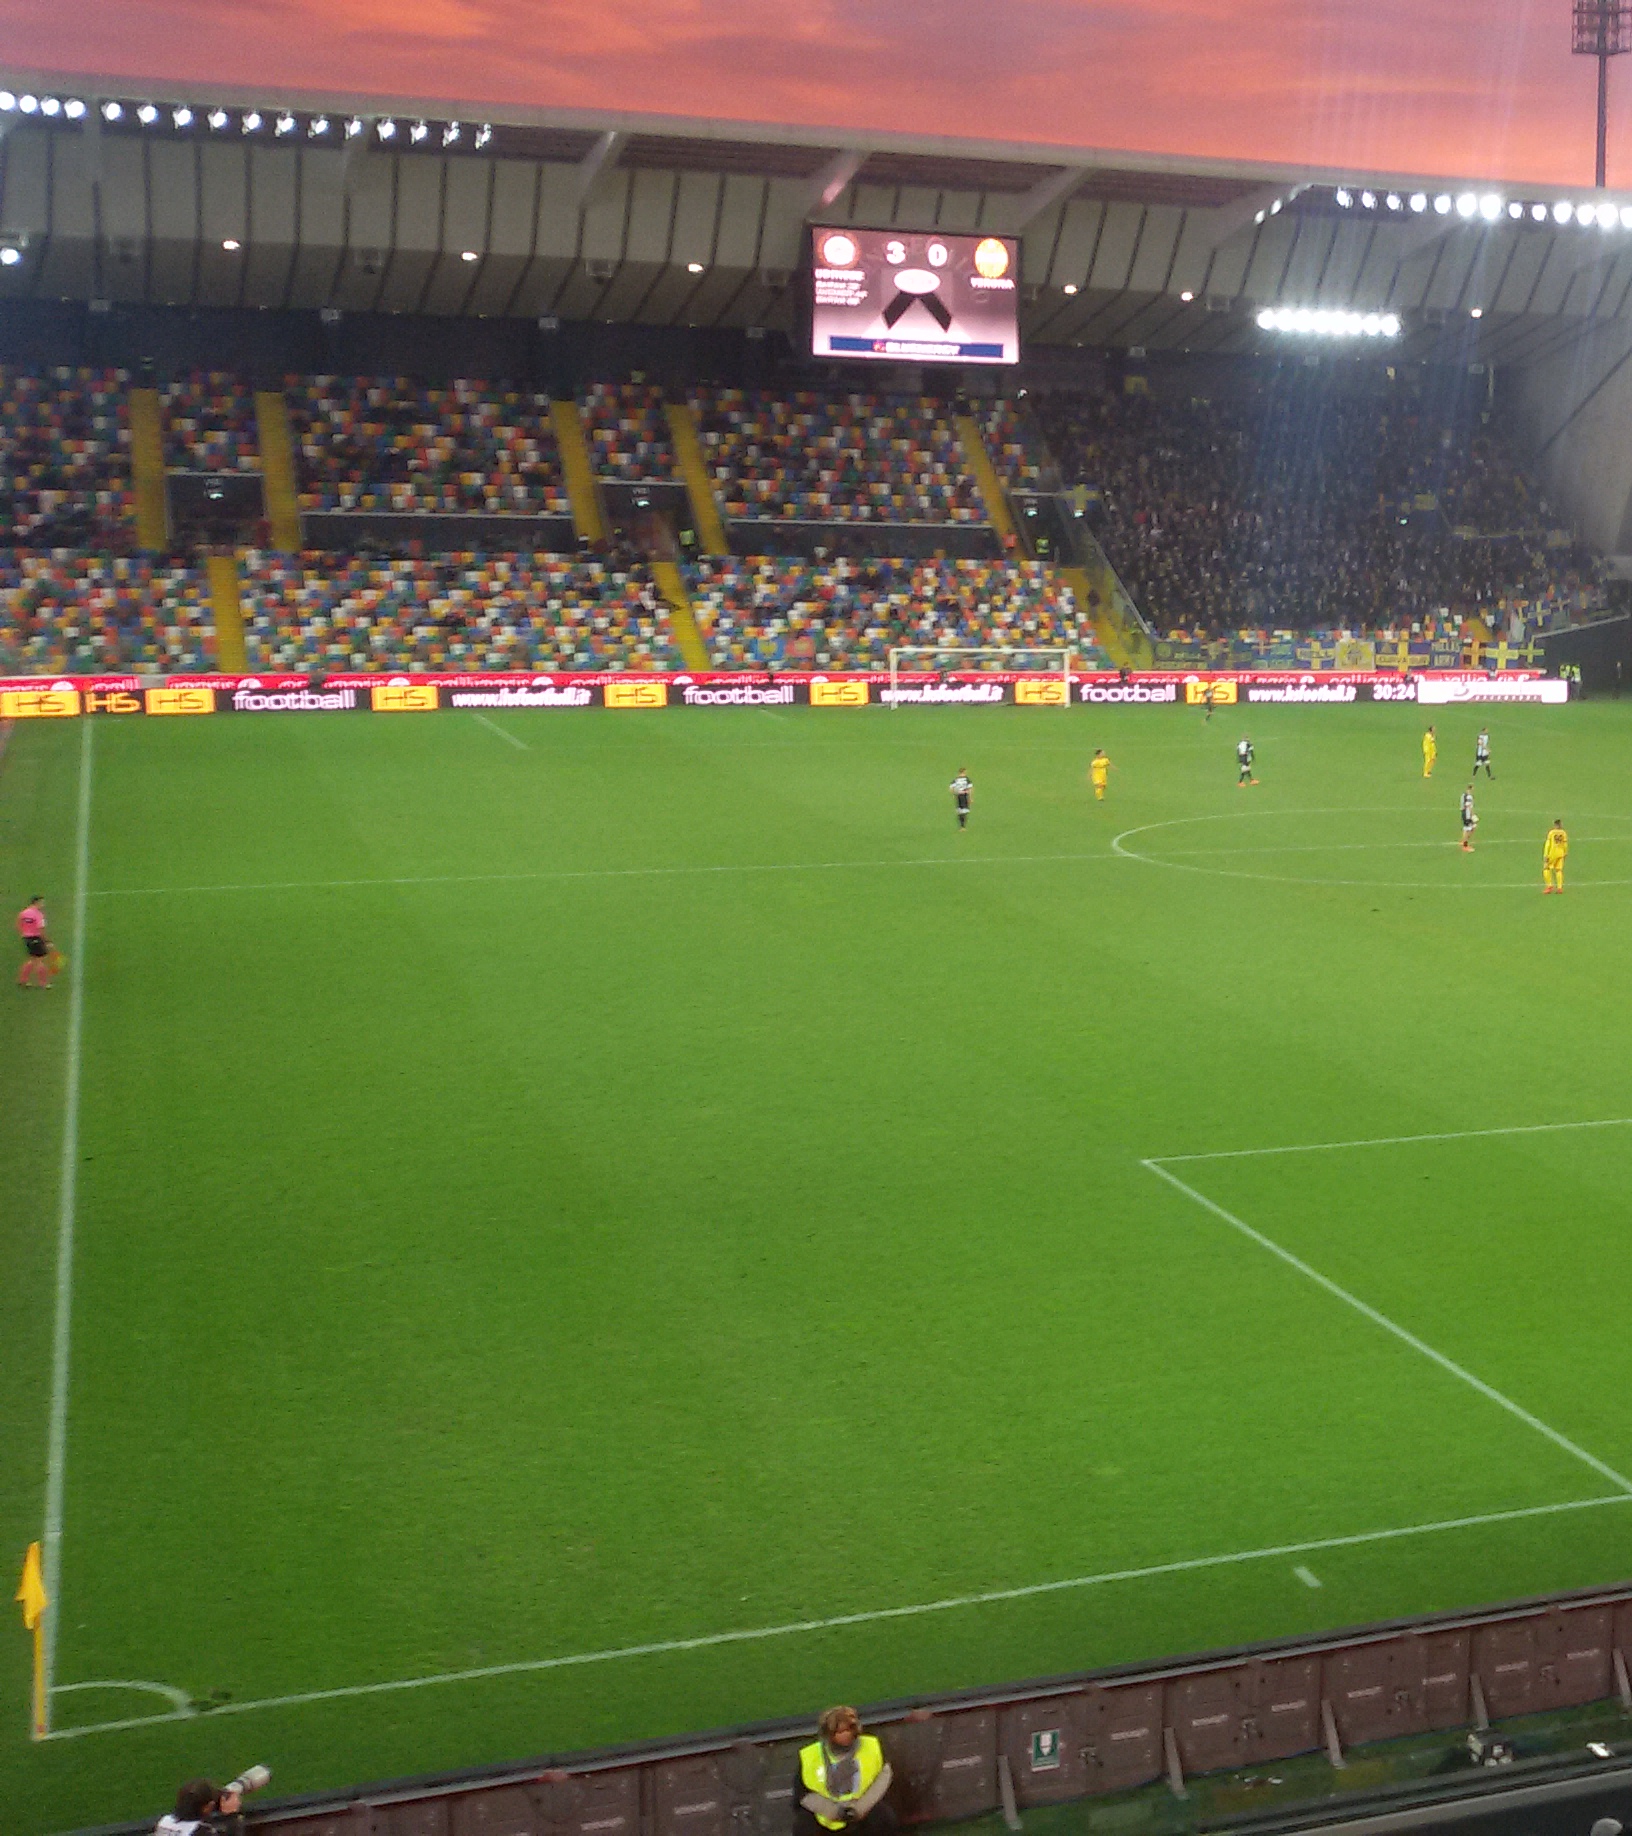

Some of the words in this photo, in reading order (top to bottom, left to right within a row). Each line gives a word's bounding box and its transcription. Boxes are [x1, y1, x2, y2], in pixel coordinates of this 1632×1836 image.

[886, 241, 906, 264] 3
[928, 243, 948, 267] 0
[231, 689, 356, 711] football
[682, 685, 794, 705] football
[1080, 683, 1176, 702] football
[1373, 684, 1415, 700] 30:24
